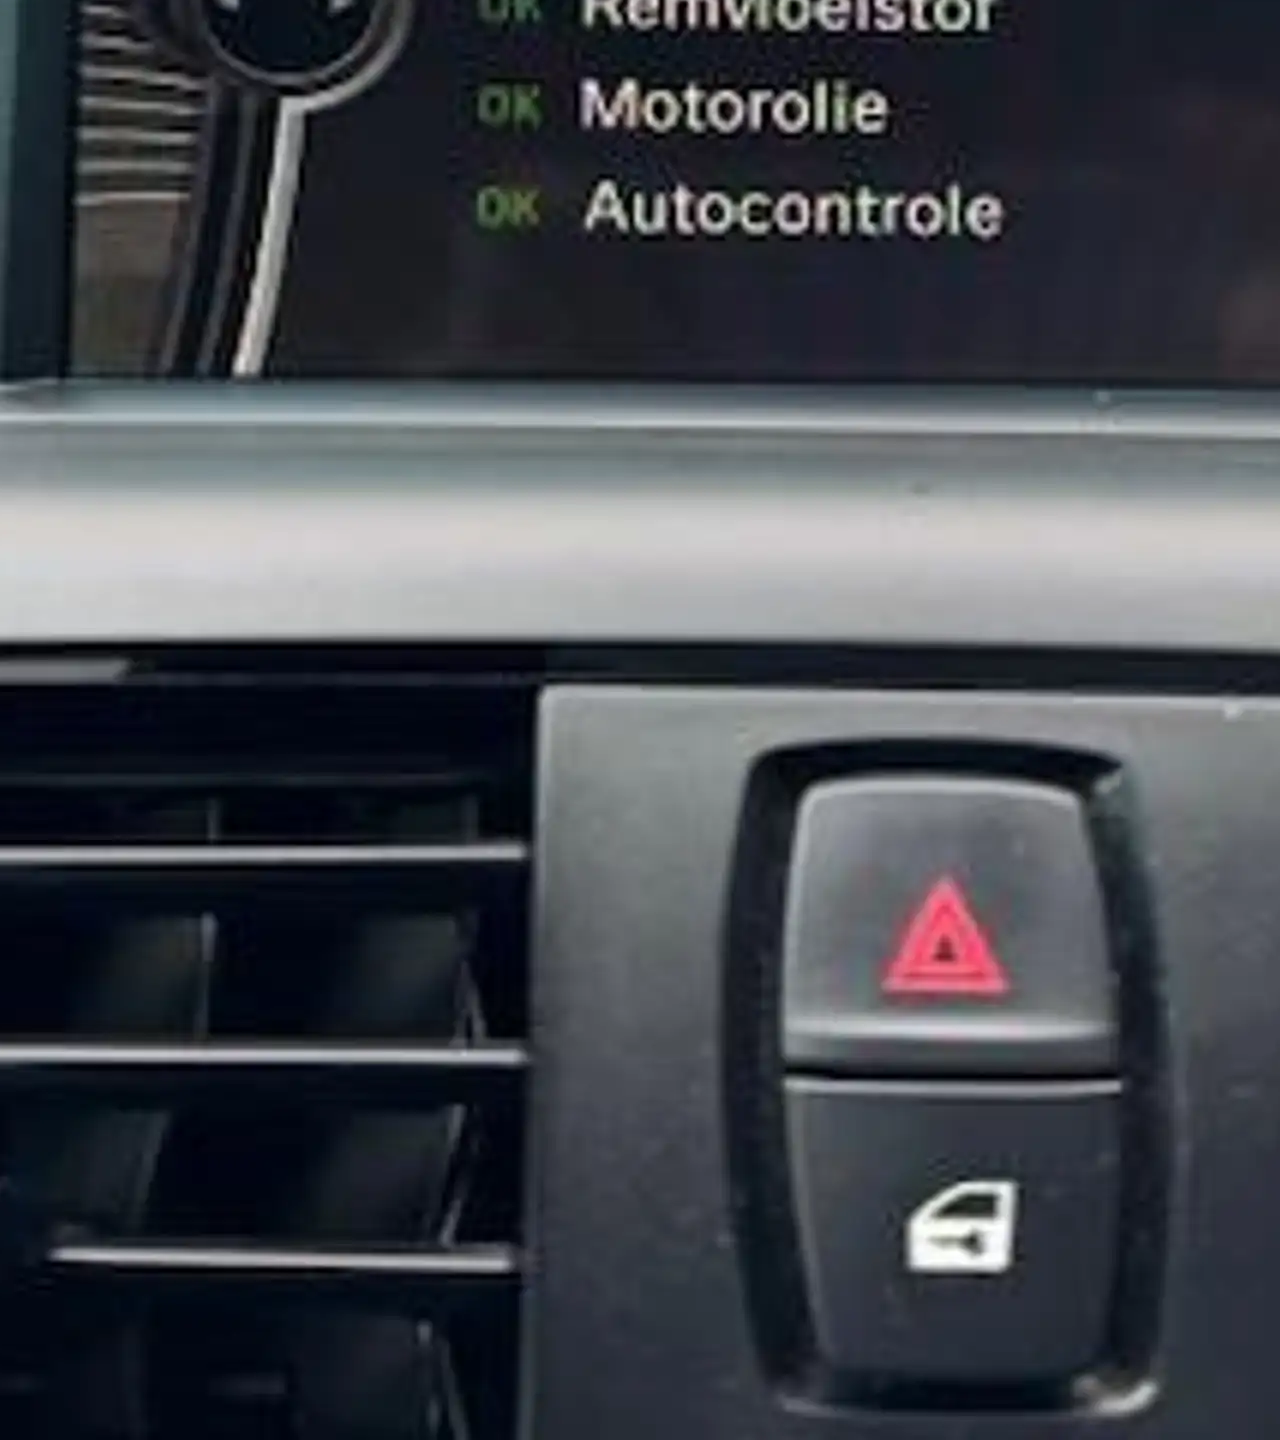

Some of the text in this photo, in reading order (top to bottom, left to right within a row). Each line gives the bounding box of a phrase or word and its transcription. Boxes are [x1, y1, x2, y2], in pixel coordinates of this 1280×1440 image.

[477, 77, 889, 135] OK Motorolie
[475, 178, 1004, 240] OK Autocontrole
